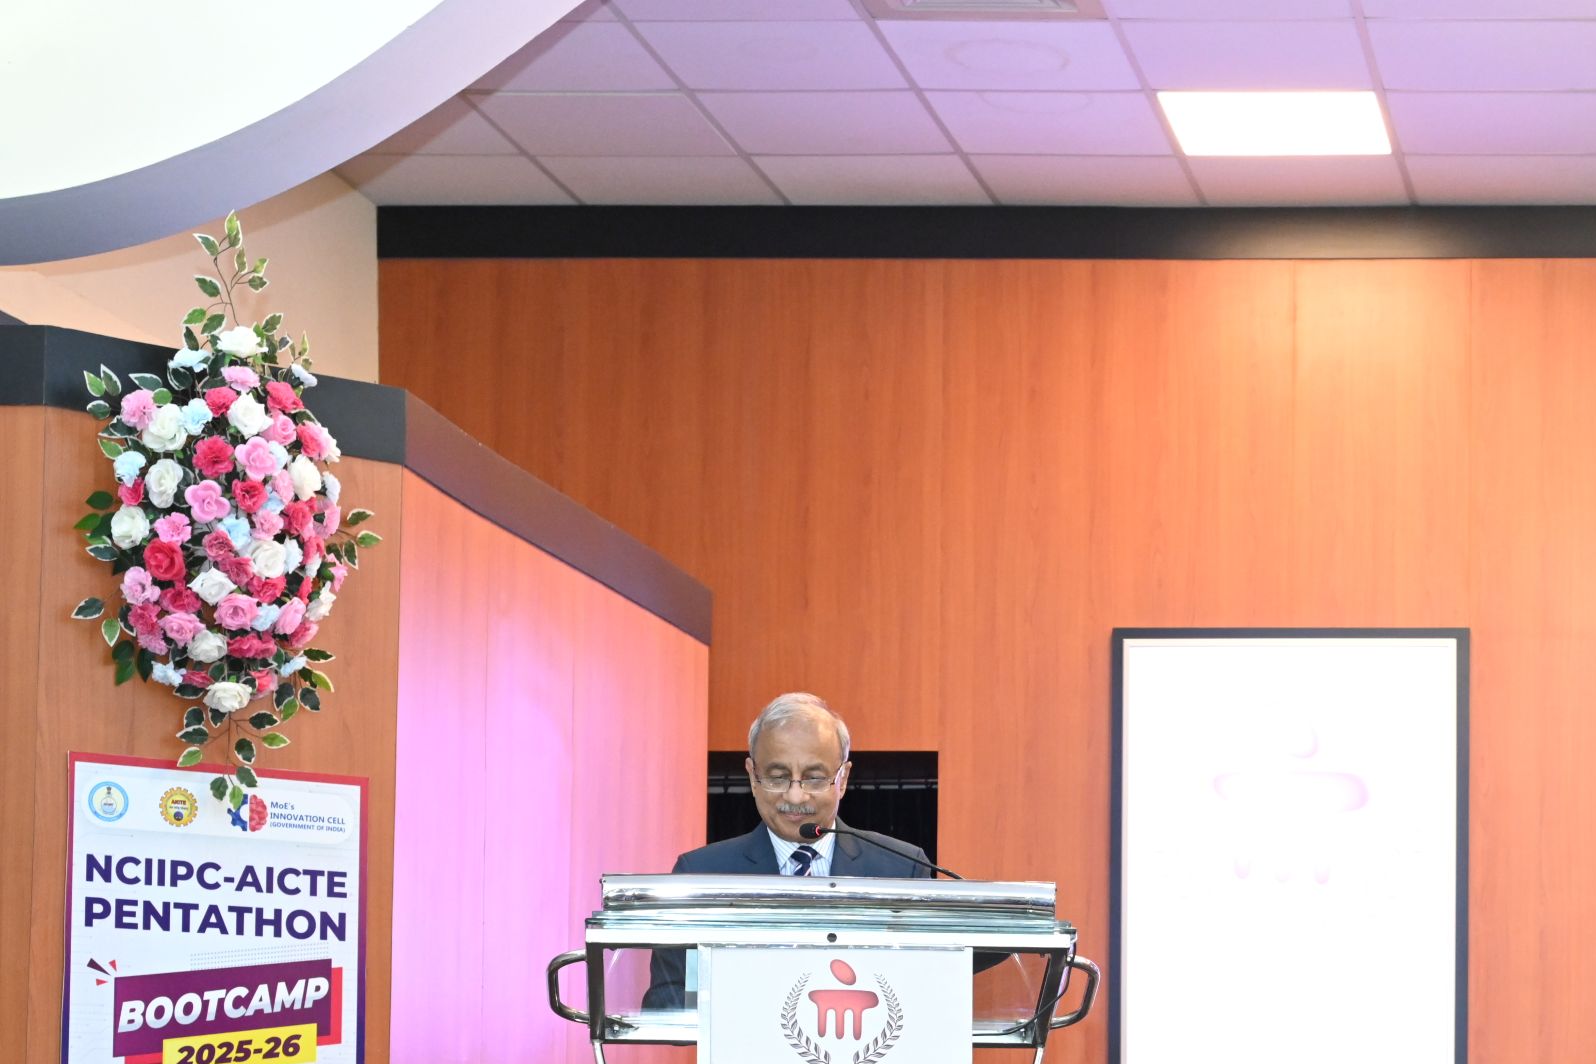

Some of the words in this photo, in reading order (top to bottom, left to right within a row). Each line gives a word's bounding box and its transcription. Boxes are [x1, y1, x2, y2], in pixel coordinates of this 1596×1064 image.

[270, 801, 295, 810] MoE's
[270, 812, 325, 823] INNOVATION
[86, 853, 348, 898] NCIIPC-AICTE
[84, 897, 347, 941] PENTATHON
[117, 975, 330, 1034] BOOTCAMP
